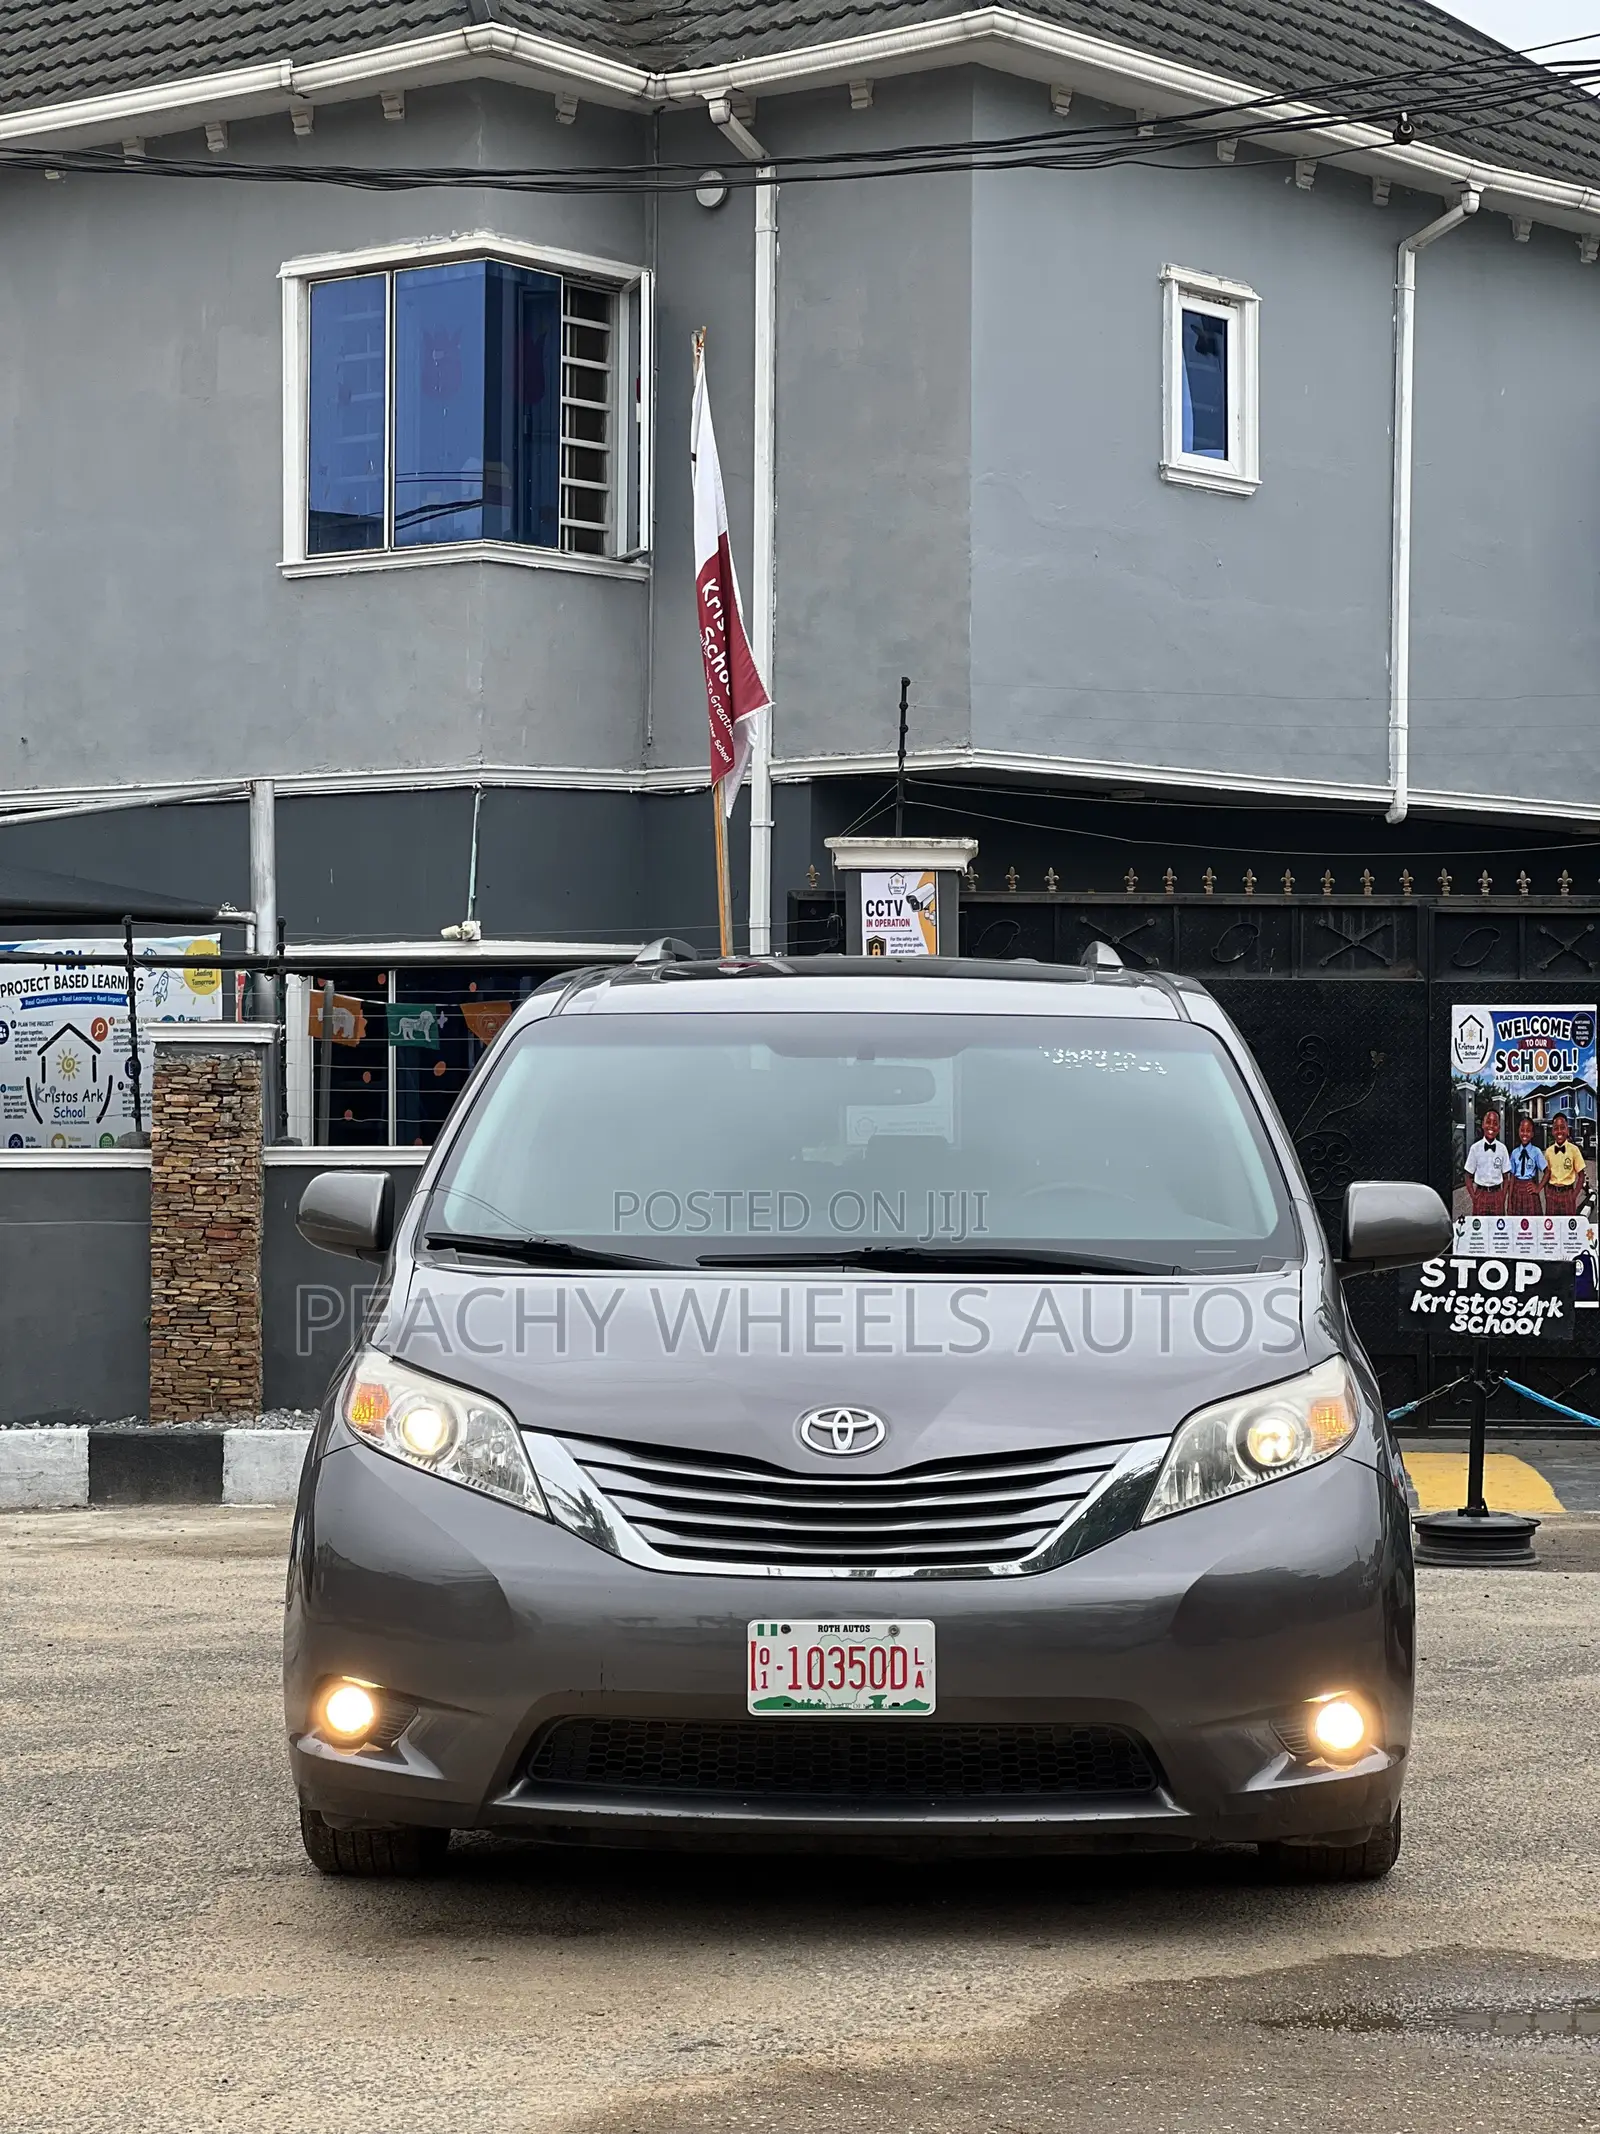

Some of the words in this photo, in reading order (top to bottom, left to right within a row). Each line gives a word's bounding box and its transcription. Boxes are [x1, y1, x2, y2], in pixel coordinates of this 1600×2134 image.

[710, 695, 735, 742] Greatne
[714, 739, 733, 763] School
[866, 900, 903, 917] CCTV
[866, 919, 873, 928] IN
[875, 919, 910, 927] OPERATION
[194, 969, 213, 978] Leading
[0, 976, 50, 998] PROJECT
[54, 974, 89, 990] BASED
[92, 973, 144, 991] LEARNIG
[191, 978, 216, 987] Tomorrow
[36, 997, 58, 1005] Questions
[73, 995, 93, 1003] Learning
[108, 995, 123, 1003] Impact
[1498, 1017, 1571, 1040] WELCOME
[1525, 1039, 1534, 1047] TO
[1535, 1039, 1548, 1047] OUR
[1495, 1048, 1579, 1073] SCHOOL!
[35, 1083, 78, 1107] Kristos
[82, 1088, 103, 1103] Ark
[53, 1105, 86, 1119] School
[1420, 1258, 1542, 1293] STOP
[817, 1624, 841, 1633] ROTH
[843, 1624, 871, 1633] AUTOS
